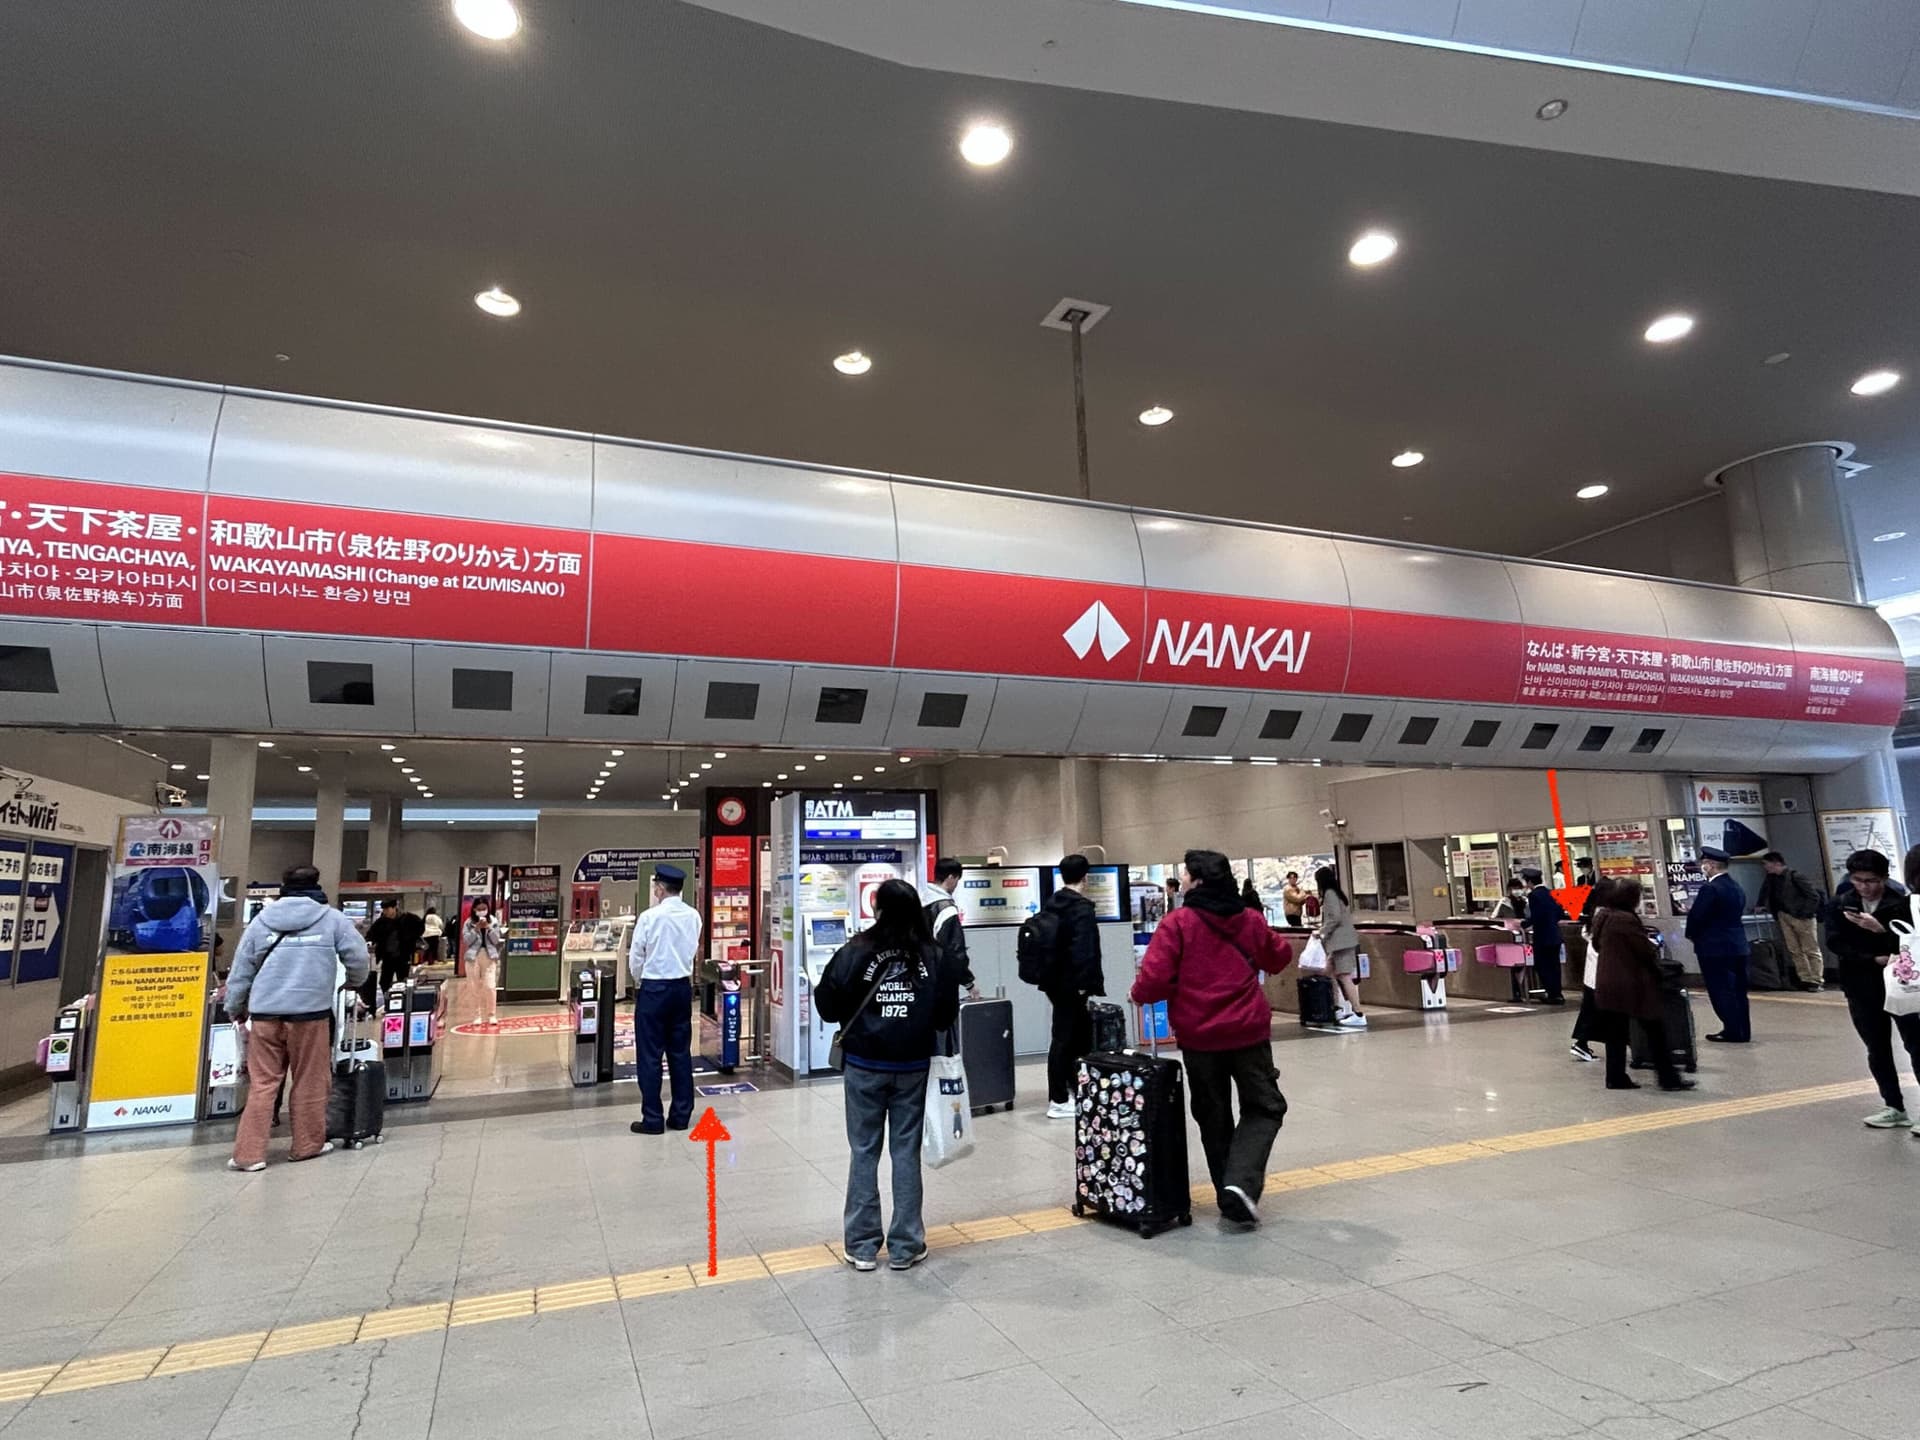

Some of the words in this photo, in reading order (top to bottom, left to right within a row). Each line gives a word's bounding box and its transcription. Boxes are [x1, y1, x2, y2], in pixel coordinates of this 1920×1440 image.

[0, 500, 197, 542] ・天下茶屋・
[43, 541, 196, 570] TENGACHAYA,
[209, 554, 366, 582] WAKAYAMASHI
[369, 568, 440, 589] (Change
[443, 576, 459, 588] at
[462, 575, 565, 597] IZUMISANO)
[209, 577, 319, 598] (이즈미사노
[323, 585, 368, 603] 환승)
[373, 588, 411, 606] 방면
[1146, 618, 1311, 673] NANKAI
[813, 800, 854, 818] ATM
[1667, 864, 1686, 873] KIX
[1673, 873, 1707, 882] NAMBA
[134, 976, 164, 985] NANKAI
[166, 975, 200, 983] RAILWAY
[880, 982, 912, 991] WORLD
[876, 993, 915, 1002] CHAMPS
[881, 1005, 908, 1017] 1972
[132, 1103, 172, 1116] NANKAI
